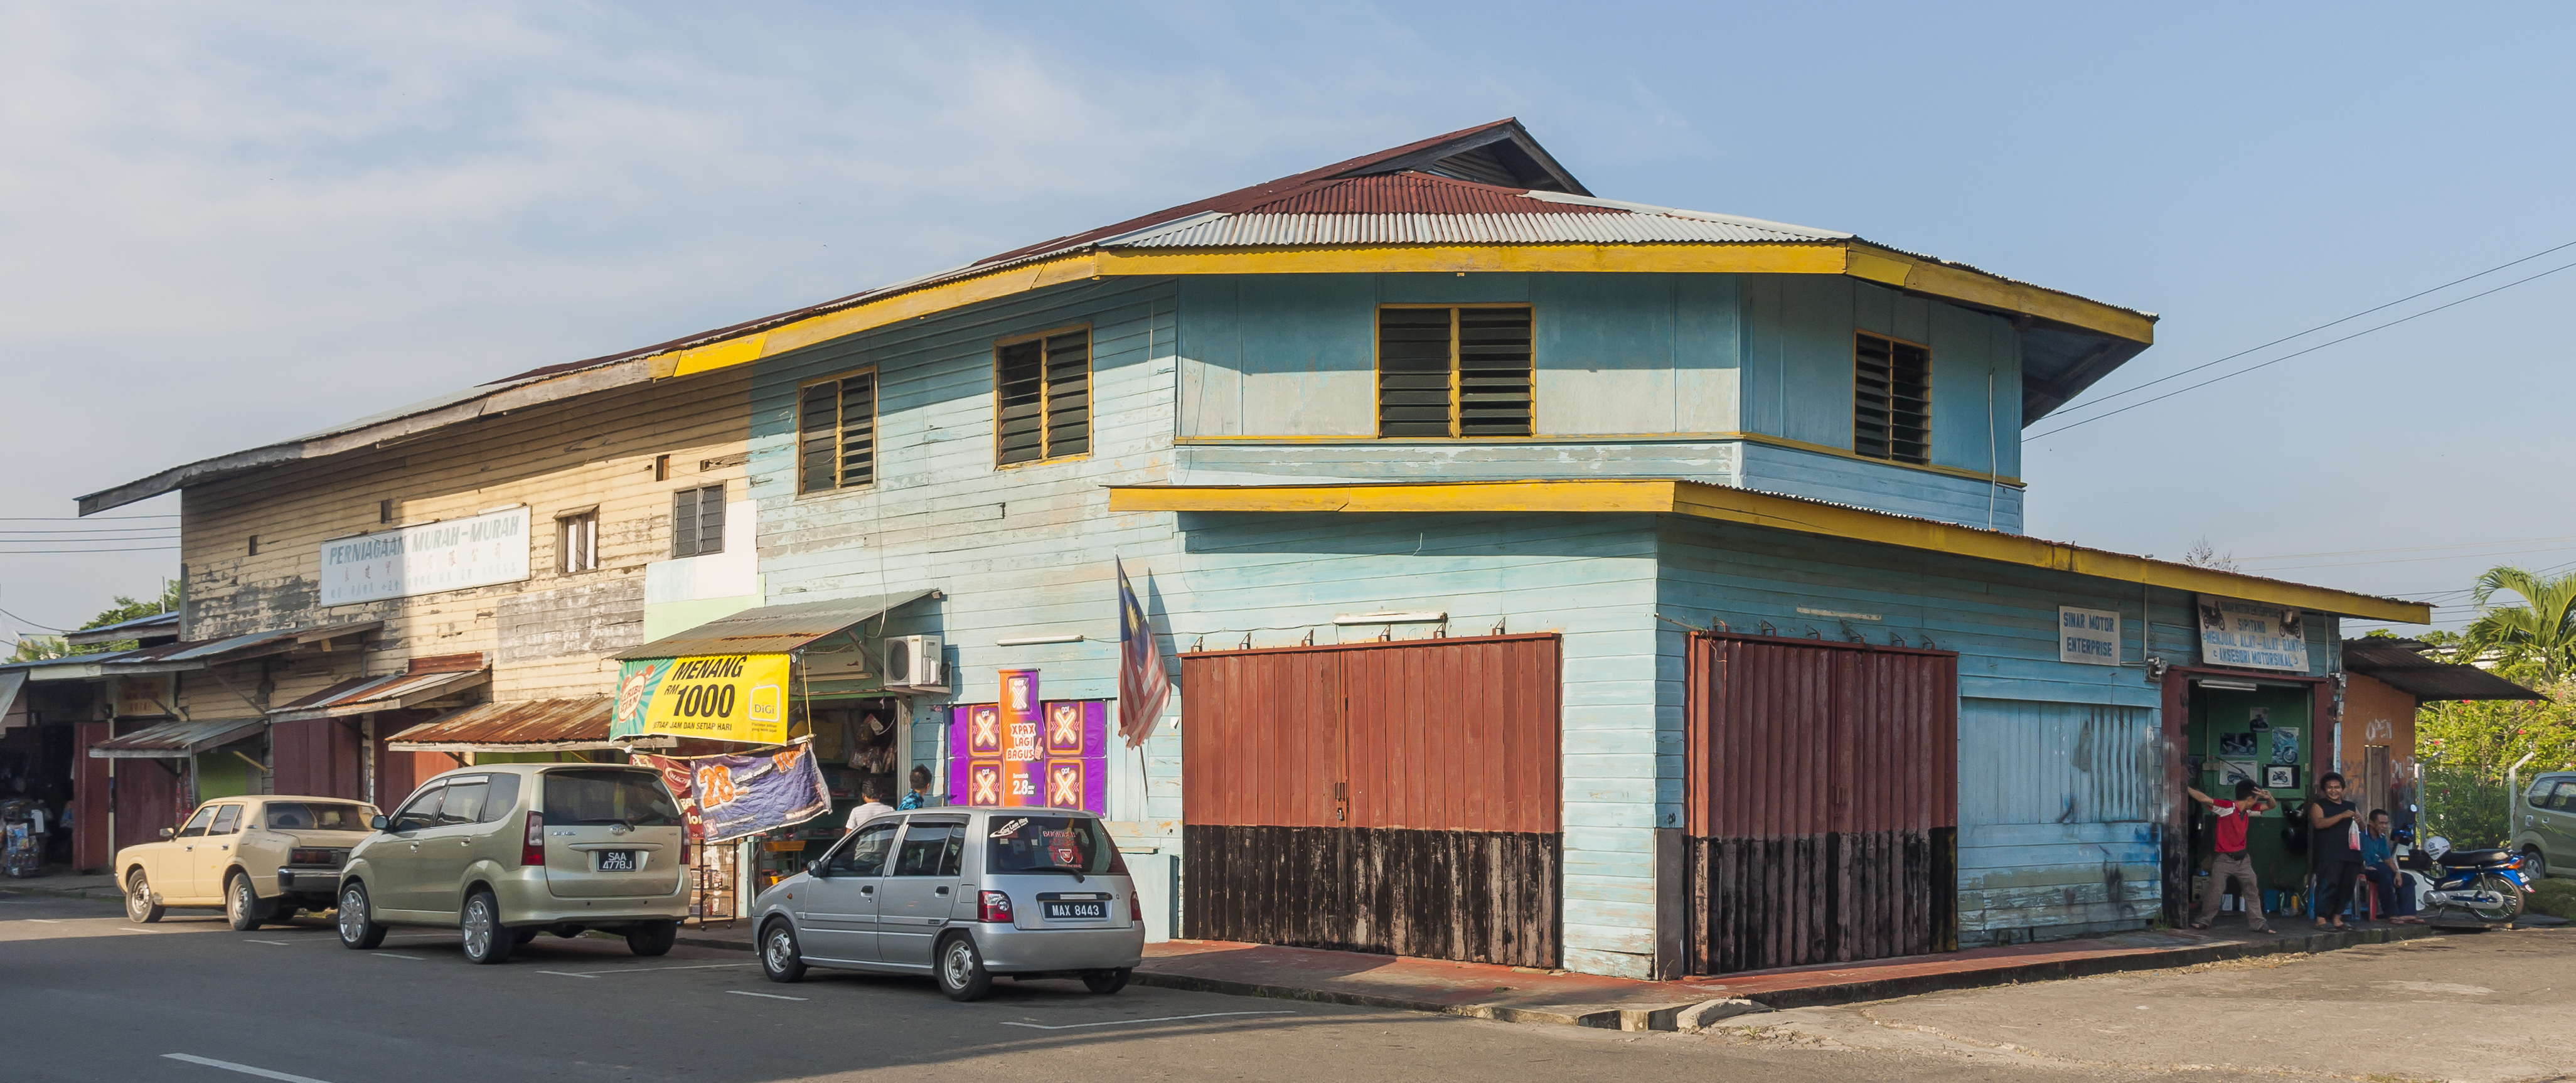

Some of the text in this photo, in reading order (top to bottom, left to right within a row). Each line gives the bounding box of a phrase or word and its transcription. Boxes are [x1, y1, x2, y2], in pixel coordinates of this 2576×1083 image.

[329, 515, 520, 565] PERNIAGAAN MURAH-MURAH
[2063, 612, 2114, 632] SINAR MOTOR
[2066, 636, 2112, 657] ENTERPRISE
[671, 655, 747, 681] MENANG
[664, 684, 735, 718] RM 1000
[683, 722, 695, 730] DAN
[717, 723, 732, 731] HARI
[1012, 725, 1035, 735] XPAX
[1015, 737, 1032, 747] LAGI
[1007, 749, 1034, 759] BAGUS
[608, 852, 627, 861] SAA
[602, 860, 632, 869] 4778J
[1052, 905, 1099, 916] MAX 8443
